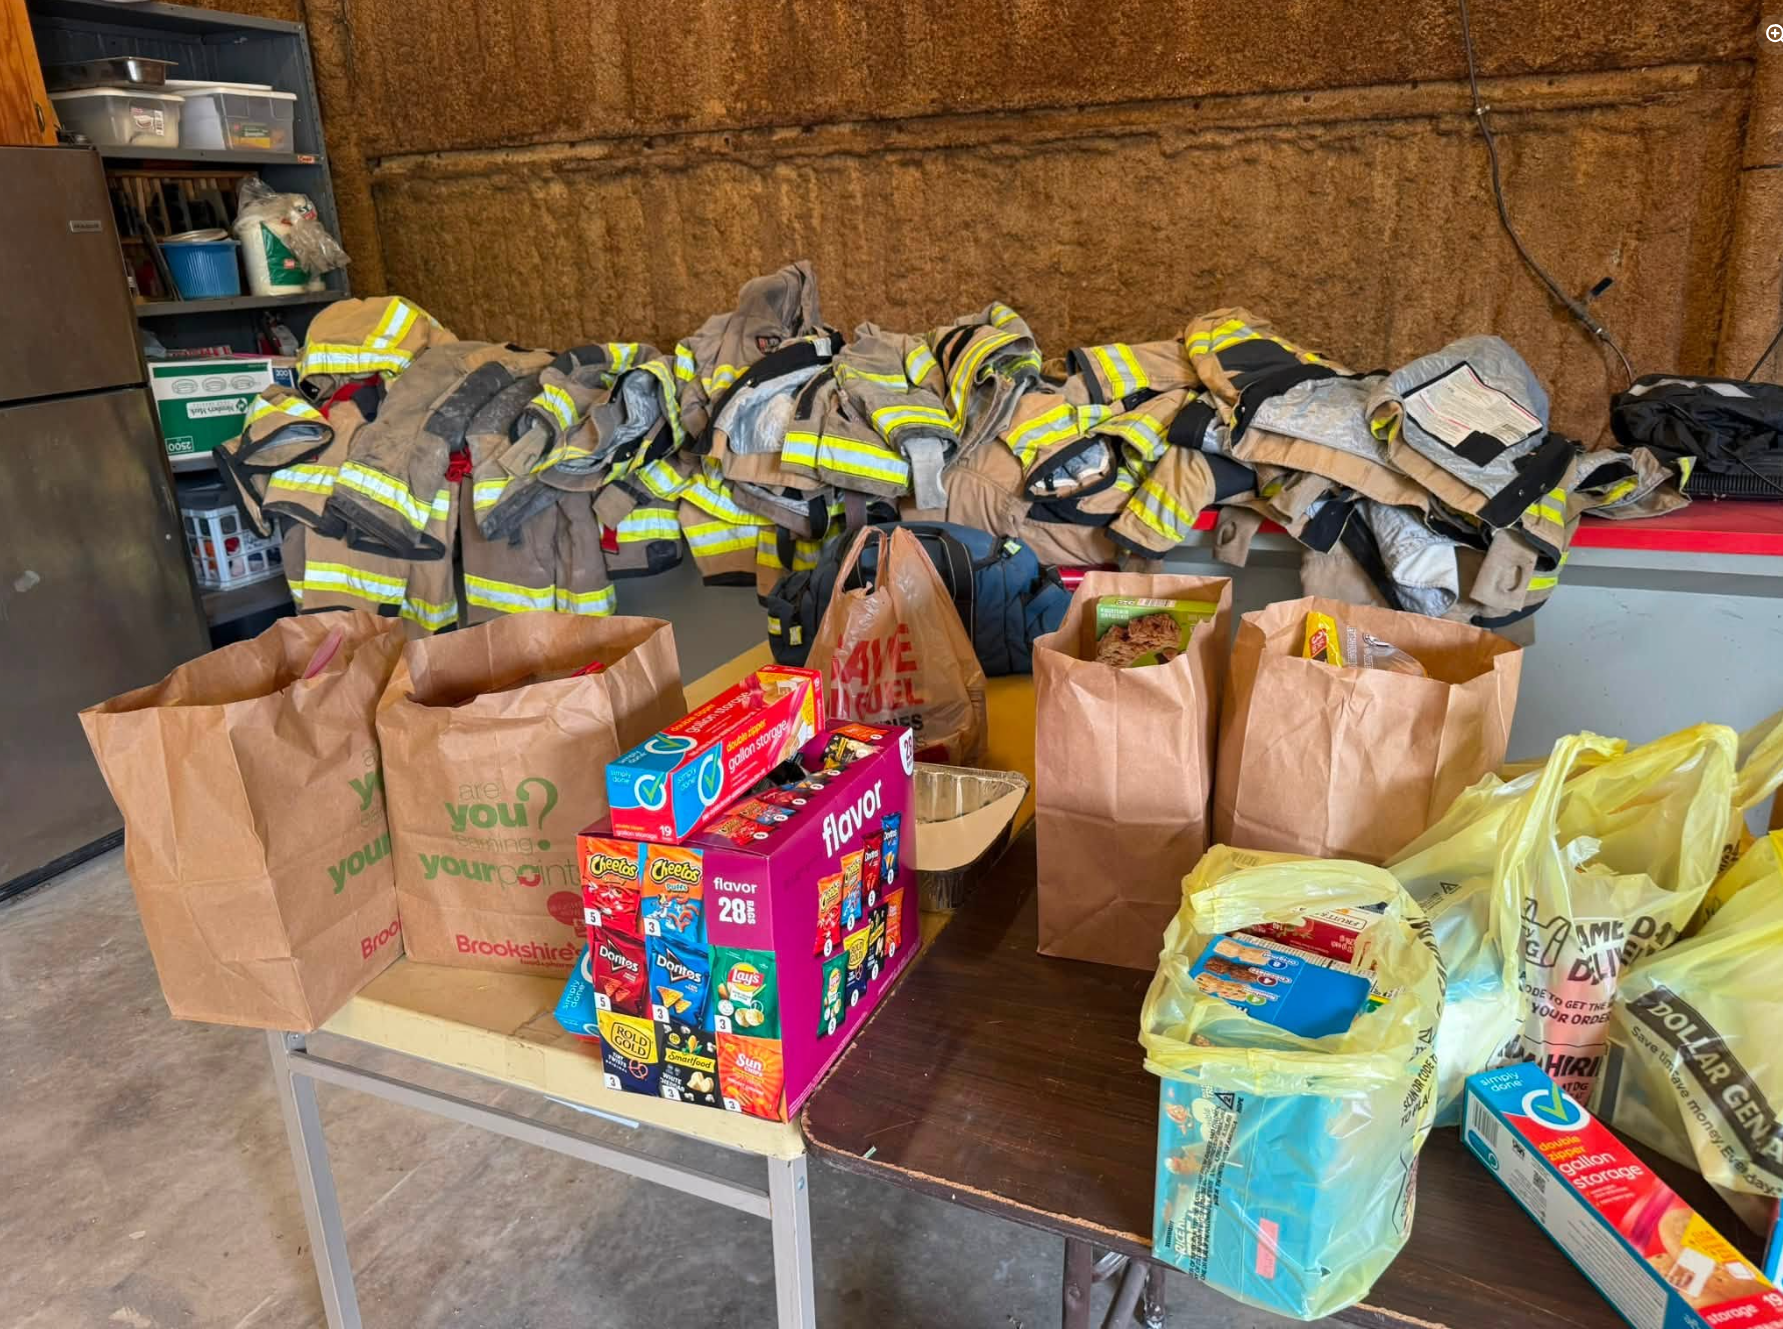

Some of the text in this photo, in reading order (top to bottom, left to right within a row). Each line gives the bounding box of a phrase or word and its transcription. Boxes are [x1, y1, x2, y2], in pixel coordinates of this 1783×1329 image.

[168, 442, 192, 451] 2500
[831, 623, 917, 686] AVE
[726, 731, 748, 751] double
[748, 718, 767, 741] zipper
[728, 739, 756, 774] gallon
[756, 719, 789, 750] storage
[611, 770, 632, 780] simply
[613, 776, 631, 785] done
[459, 780, 501, 801] are
[445, 802, 529, 833] you
[822, 779, 882, 859] flavor
[659, 825, 672, 837] 19
[590, 854, 638, 880] Cheetos
[650, 858, 702, 884] Cheetos
[713, 877, 757, 894] flavor
[589, 911, 597, 923] 5
[718, 897, 757, 925] 28 BAGS
[648, 921, 655, 933] 3
[599, 945, 639, 972] Doritos
[656, 954, 703, 984] Doritos
[731, 968, 760, 987] Lay's
[562, 979, 580, 1010] simply
[599, 997, 606, 1008] 5
[1522, 984, 1606, 1011] ODE TO GET THE
[657, 1009, 664, 1020] 3
[1531, 1002, 1569, 1024] YOUR
[719, 1019, 726, 1030] 3
[616, 1025, 649, 1048] ROLD
[1631, 1025, 1659, 1055] Save
[1647, 1000, 1731, 1085] DOLLAR
[614, 1035, 647, 1057] GOLD
[607, 1055, 627, 1068] TWISTS
[612, 1052, 624, 1061] TINY
[667, 1051, 712, 1069] Smartfood
[736, 1053, 763, 1071] Sun
[609, 1077, 616, 1087] 3
[662, 1072, 682, 1085] WHITE
[1417, 1062, 1435, 1086] CODE
[1480, 1071, 1519, 1087] simply
[667, 1088, 674, 1098] 3
[1412, 1077, 1424, 1095] QR
[1490, 1079, 1522, 1092] done
[1573, 1081, 1589, 1091] DG
[729, 1100, 736, 1110] 3
[1225, 1095, 1234, 1104] 2
[1402, 1086, 1420, 1111] SCAN
[1400, 1111, 1412, 1128] TO
[1538, 1135, 1582, 1151] double
[1547, 1146, 1587, 1163] zipper
[1558, 1153, 1616, 1176] gallon
[1573, 1164, 1644, 1190] storage
[1174, 1229, 1187, 1255] RICE
[1763, 1292, 1783, 1310] 19
[1706, 1303, 1760, 1325] storage
